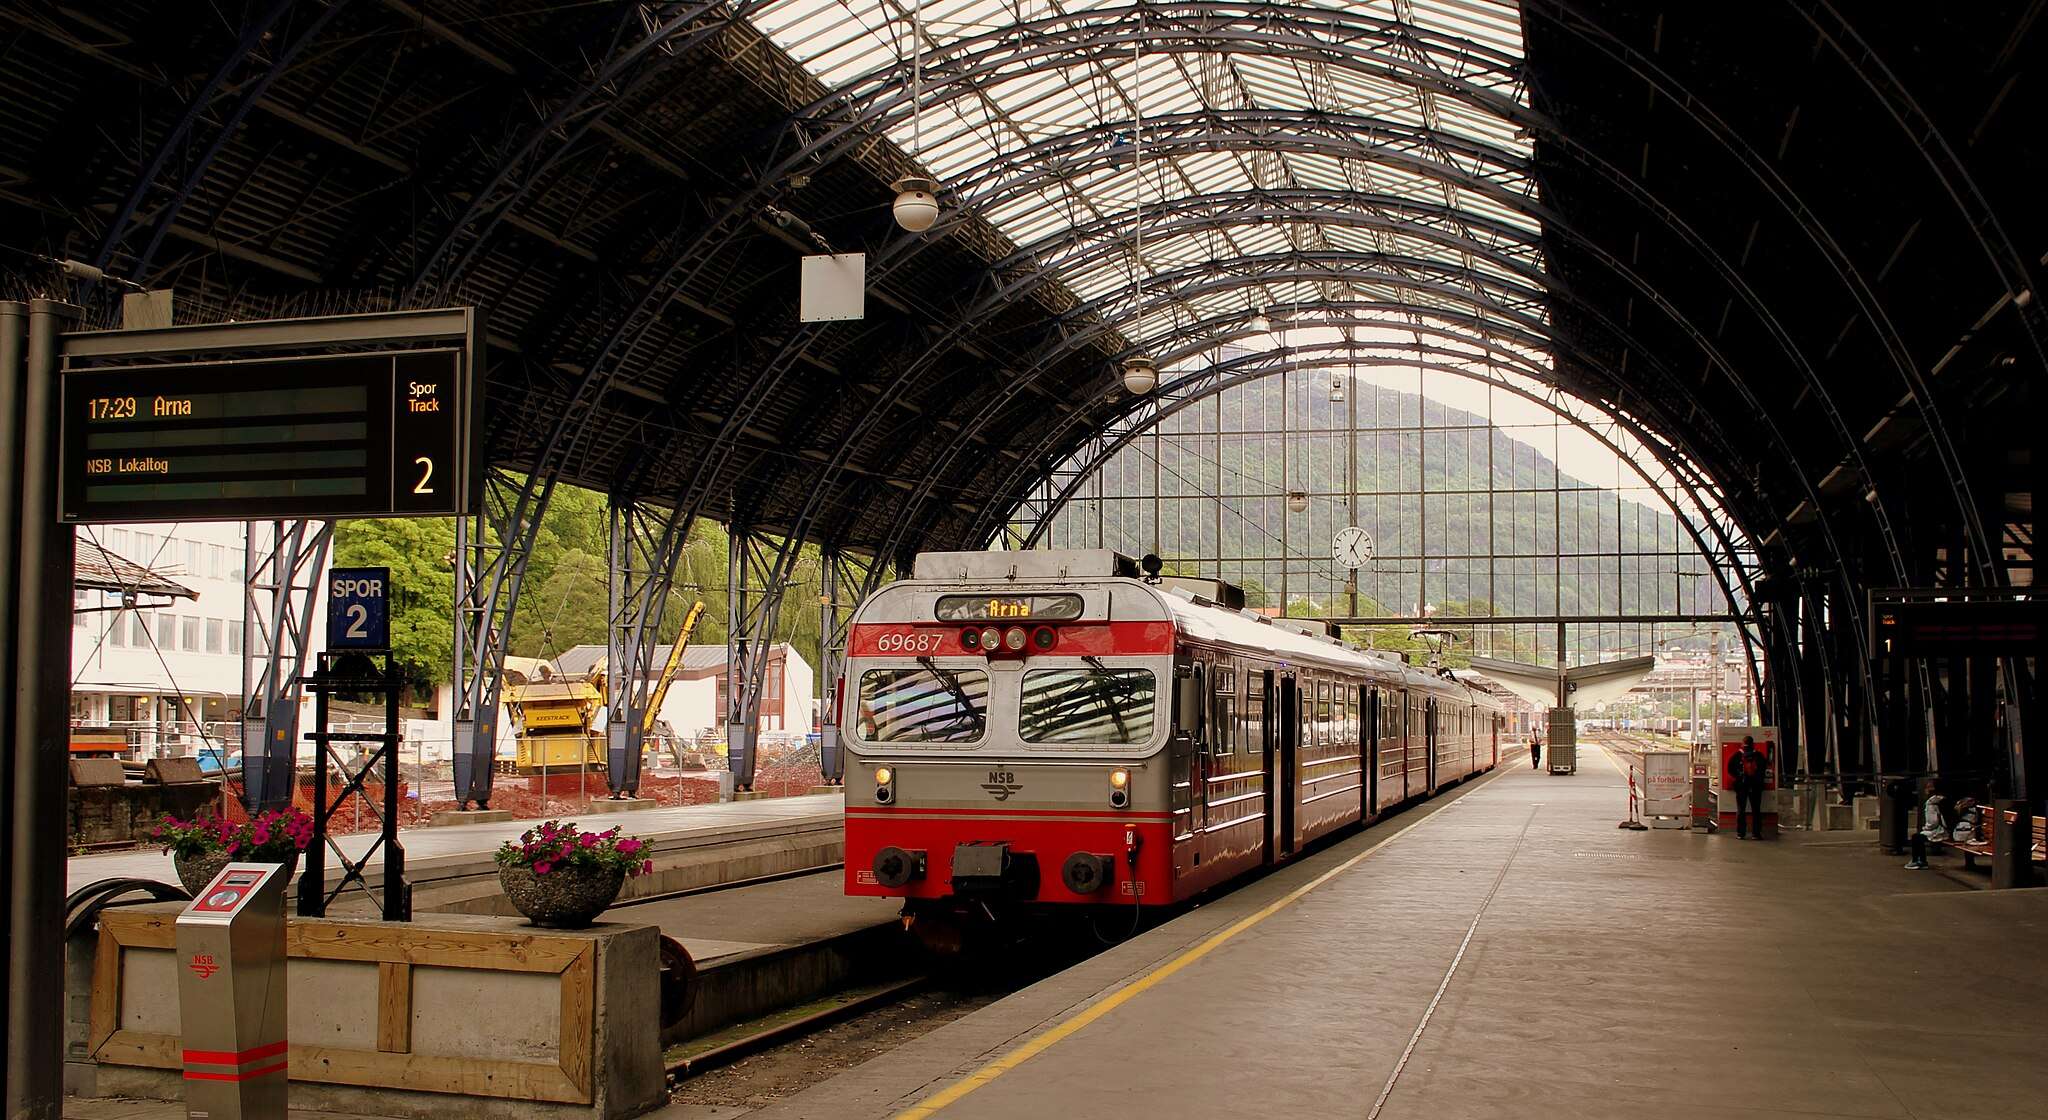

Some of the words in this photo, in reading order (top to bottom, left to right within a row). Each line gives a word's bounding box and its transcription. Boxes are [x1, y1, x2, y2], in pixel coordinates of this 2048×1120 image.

[409, 382, 437, 398] Spor
[89, 398, 136, 418] 17:29
[154, 397, 192, 416] Arna
[408, 398, 439, 412] Track
[87, 459, 112, 473] NSB
[119, 458, 168, 473] Lokaltog
[414, 457, 433, 493] 2
[334, 579, 382, 597] SPOR
[990, 600, 1029, 617] Arna
[346, 604, 367, 637] 2
[878, 634, 943, 651] 69687
[1884, 639, 1891, 652] 1
[989, 771, 1015, 783] NSB
[194, 955, 213, 965] NSB
